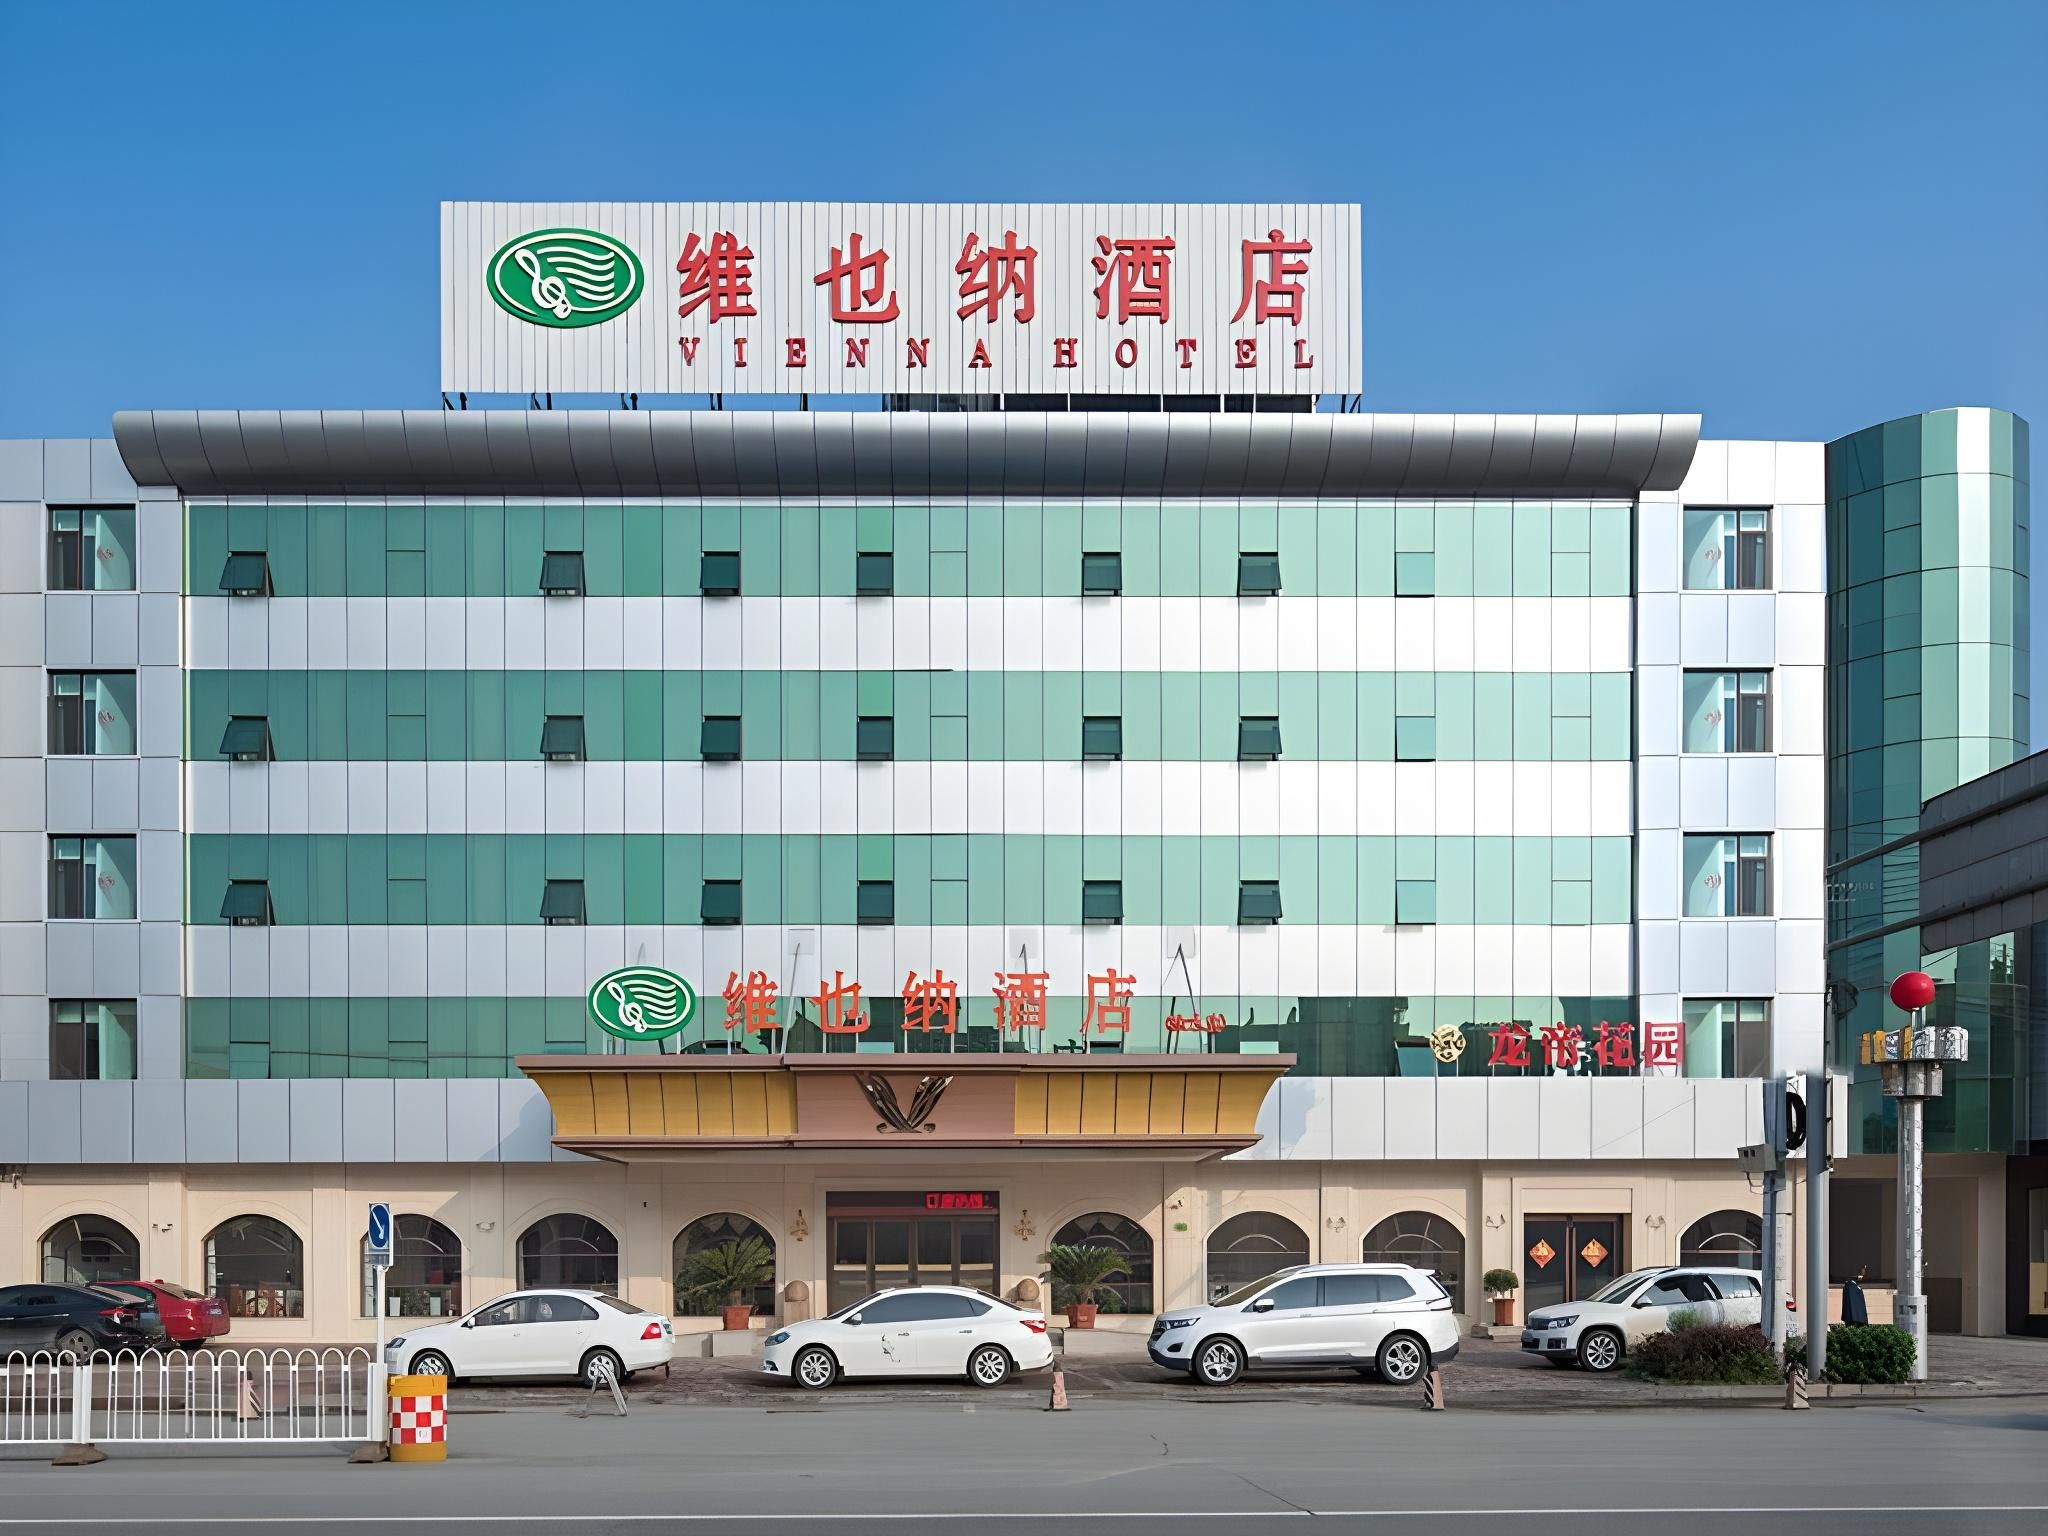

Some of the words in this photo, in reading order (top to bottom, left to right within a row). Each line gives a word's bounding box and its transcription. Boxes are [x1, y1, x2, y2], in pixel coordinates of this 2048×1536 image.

[677, 228, 1313, 325] 维也纳酒店
[679, 336, 992, 369] VIENNA
[1053, 336, 1313, 369] HOTEL
[721, 968, 1137, 1035] 维也纳酒店
